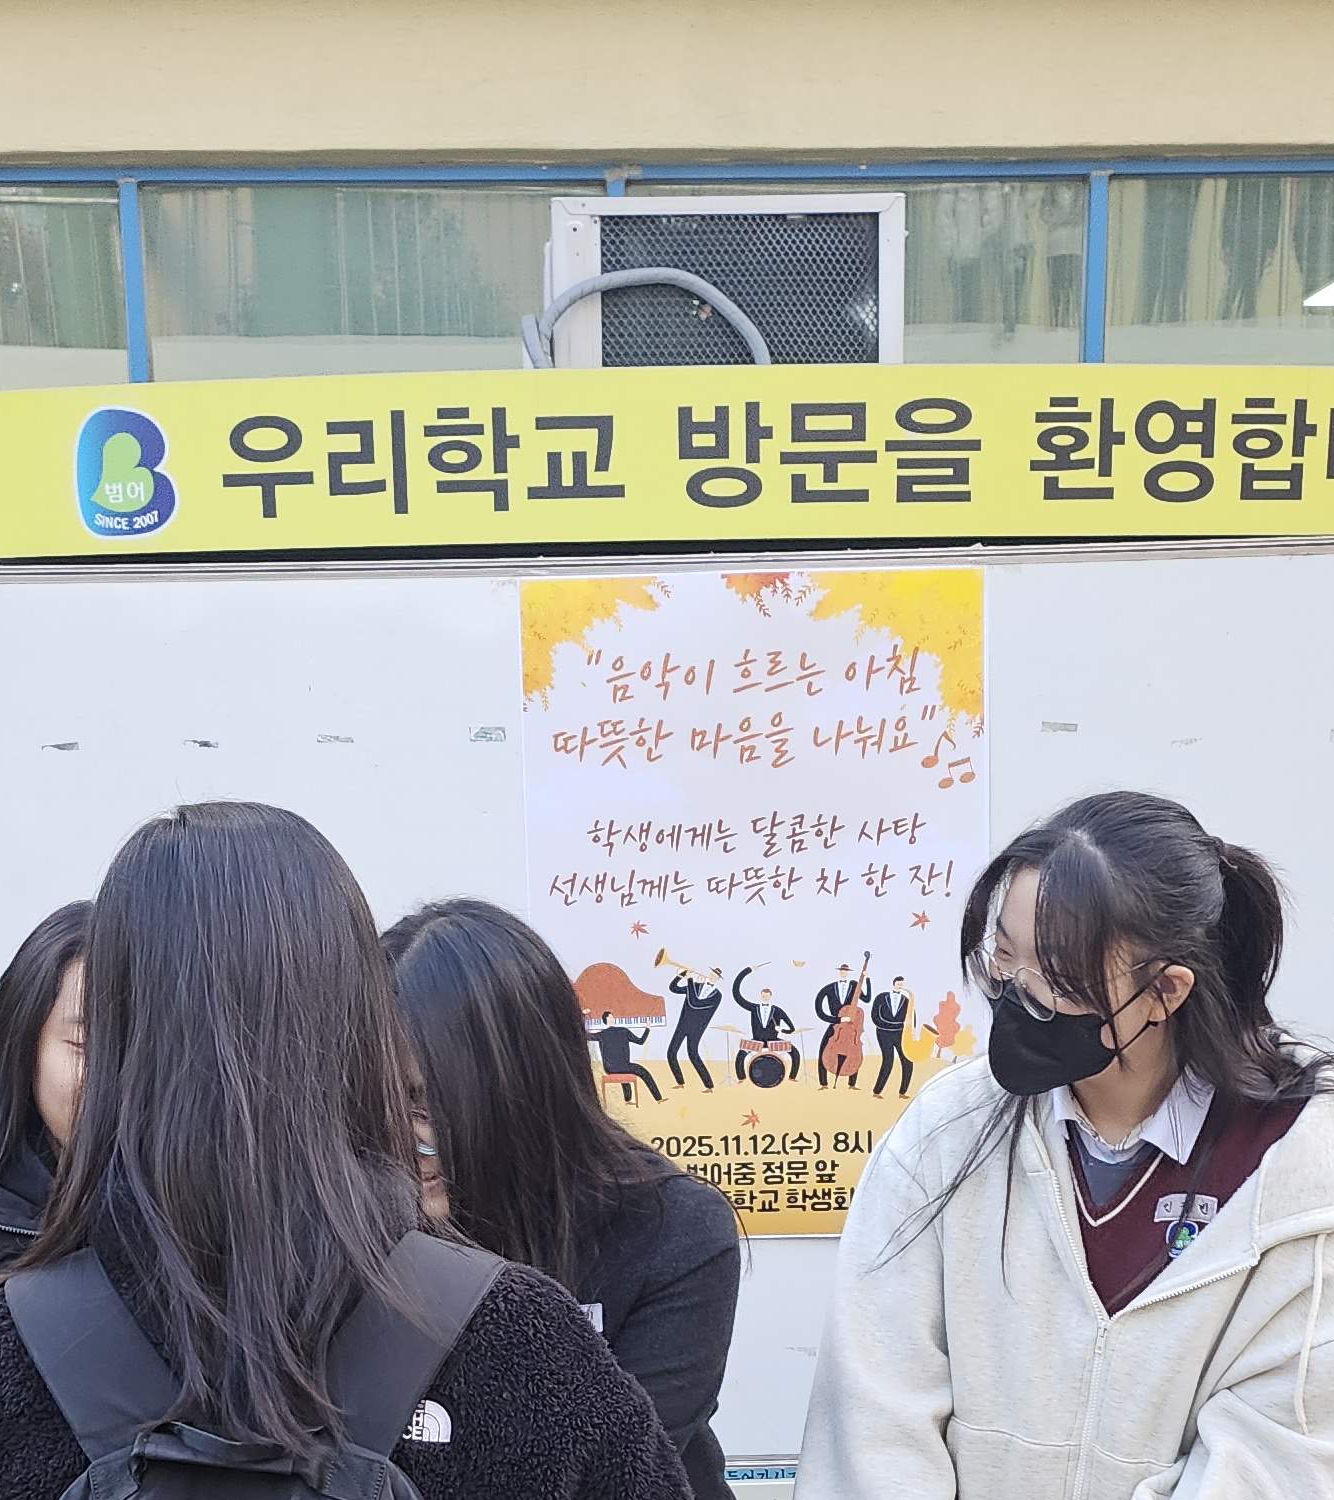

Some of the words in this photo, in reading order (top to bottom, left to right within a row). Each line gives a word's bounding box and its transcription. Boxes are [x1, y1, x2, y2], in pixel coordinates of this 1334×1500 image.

[222, 404, 625, 520] 우리학교
[677, 397, 982, 509] 방문을
[105, 482, 145, 503] 범어
[94, 514, 129, 530] SINCE
[133, 511, 159, 528] 2007
[732, 648, 827, 697] 흐르는
[844, 645, 921, 694] 아침
[552, 718, 674, 769] 따뜻한
[690, 711, 796, 769] 마음을
[587, 818, 739, 857] 학생에게는
[751, 811, 845, 858] 달콤한
[857, 813, 927, 848] 사탕
[548, 869, 695, 907] 선생님께는
[707, 866, 803, 906] 따뜻한
[815, 868, 849, 899] 차
[861, 862, 896, 898] 한
[909, 860, 955, 899] 잔!
[832, 1130, 873, 1154] 8시
[762, 1160, 809, 1185] 정문
[815, 1159, 839, 1183] 앞
[726, 1189, 781, 1213] 학교
